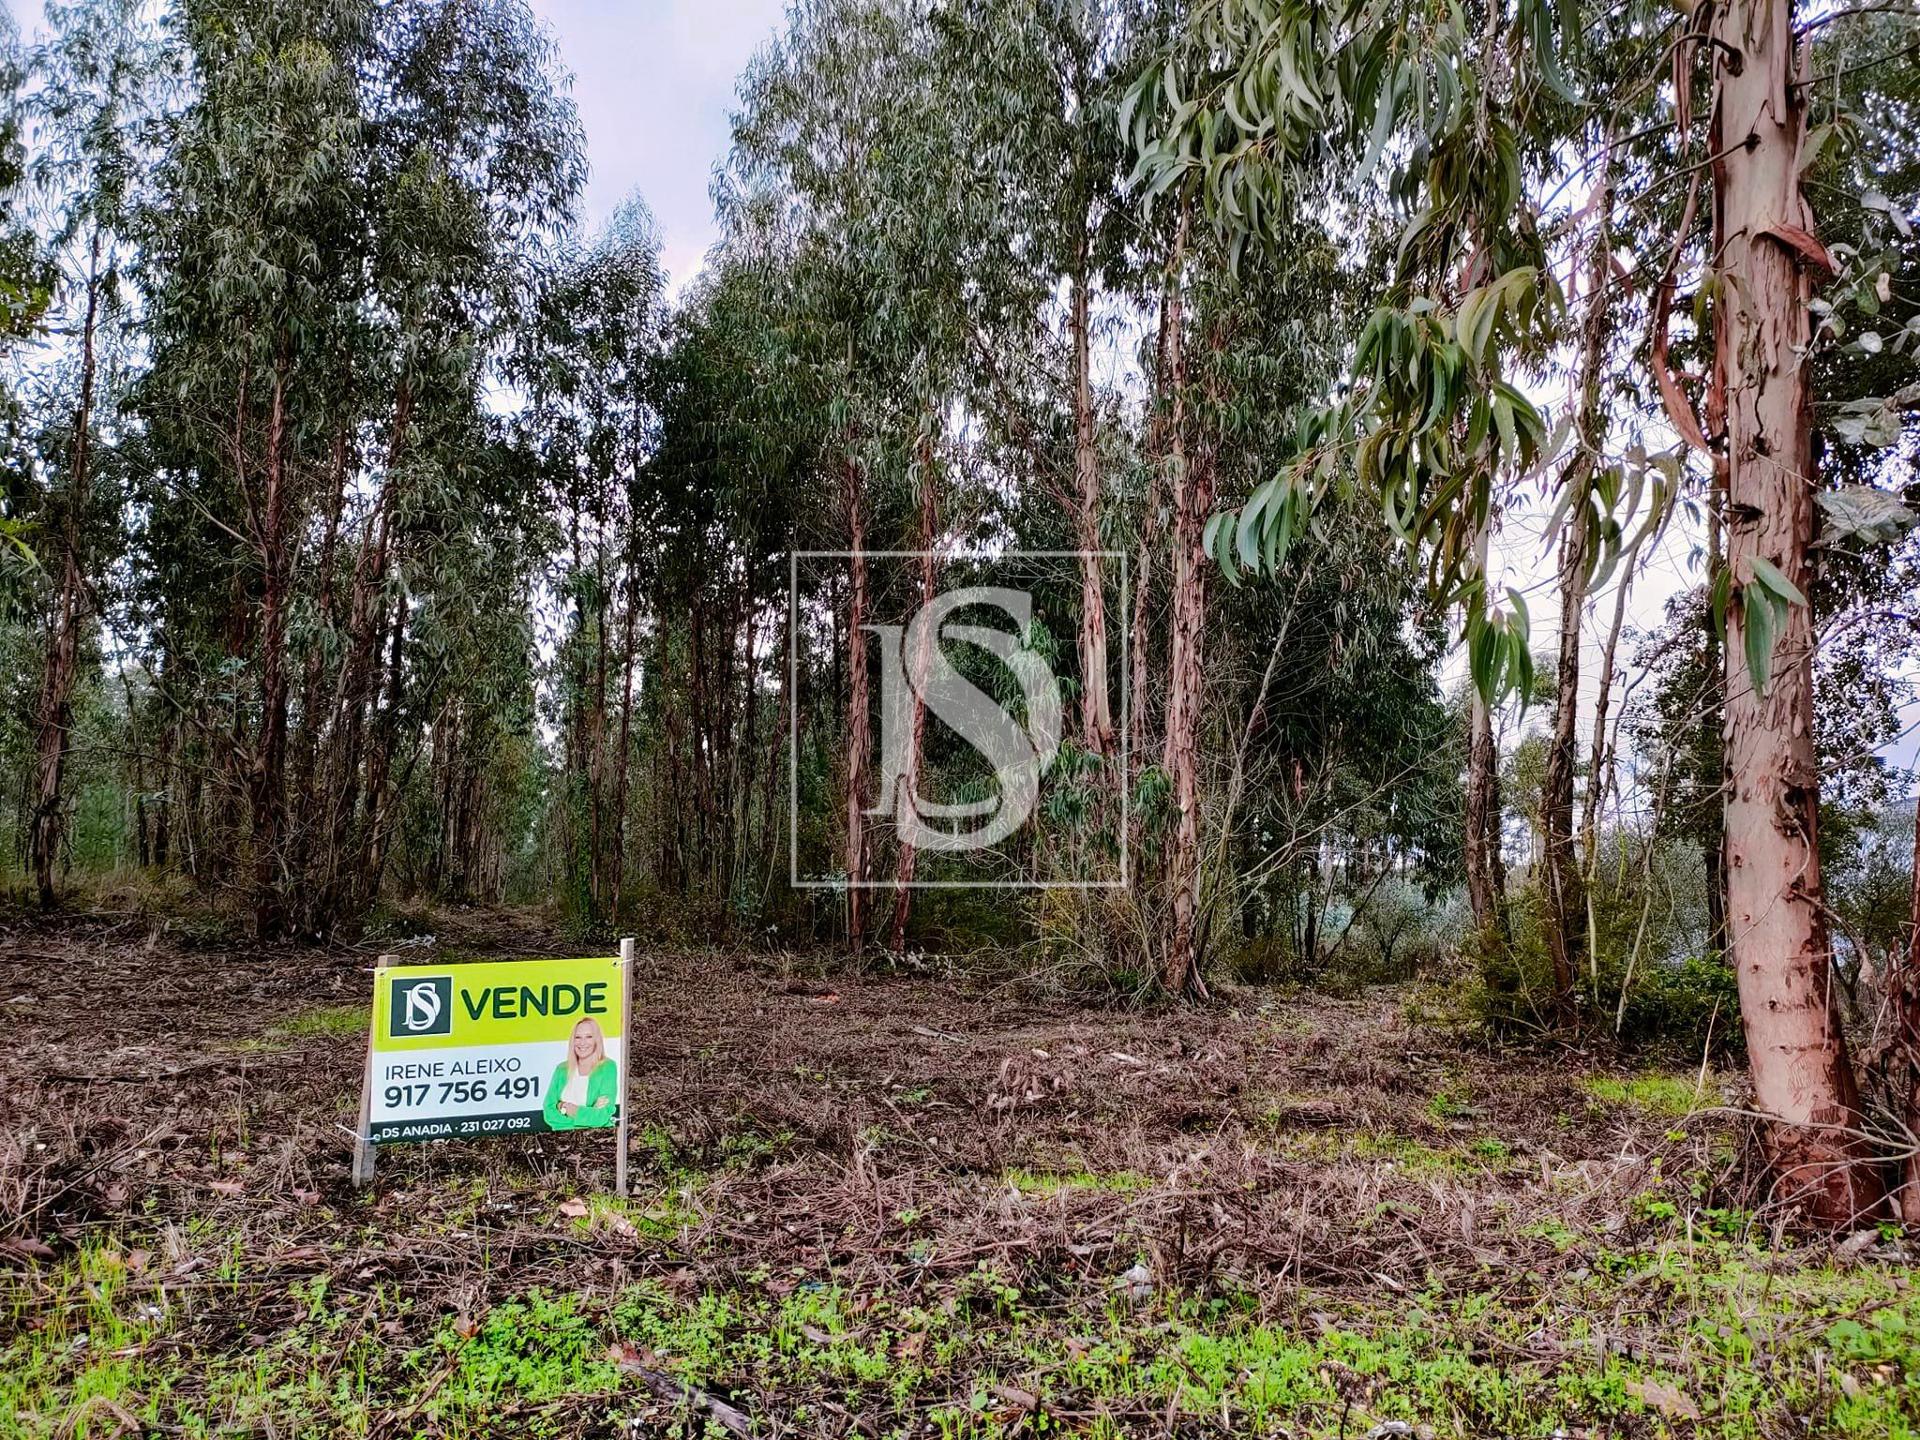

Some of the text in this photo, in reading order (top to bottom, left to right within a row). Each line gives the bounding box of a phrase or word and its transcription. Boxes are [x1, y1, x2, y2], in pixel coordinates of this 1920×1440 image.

[461, 982, 608, 1021] VENDE
[385, 1058, 521, 1080] IRENE ALEIXO
[384, 1076, 540, 1108] 917 756 491
[382, 1117, 531, 1139] DS ANADIA 231 027 092
